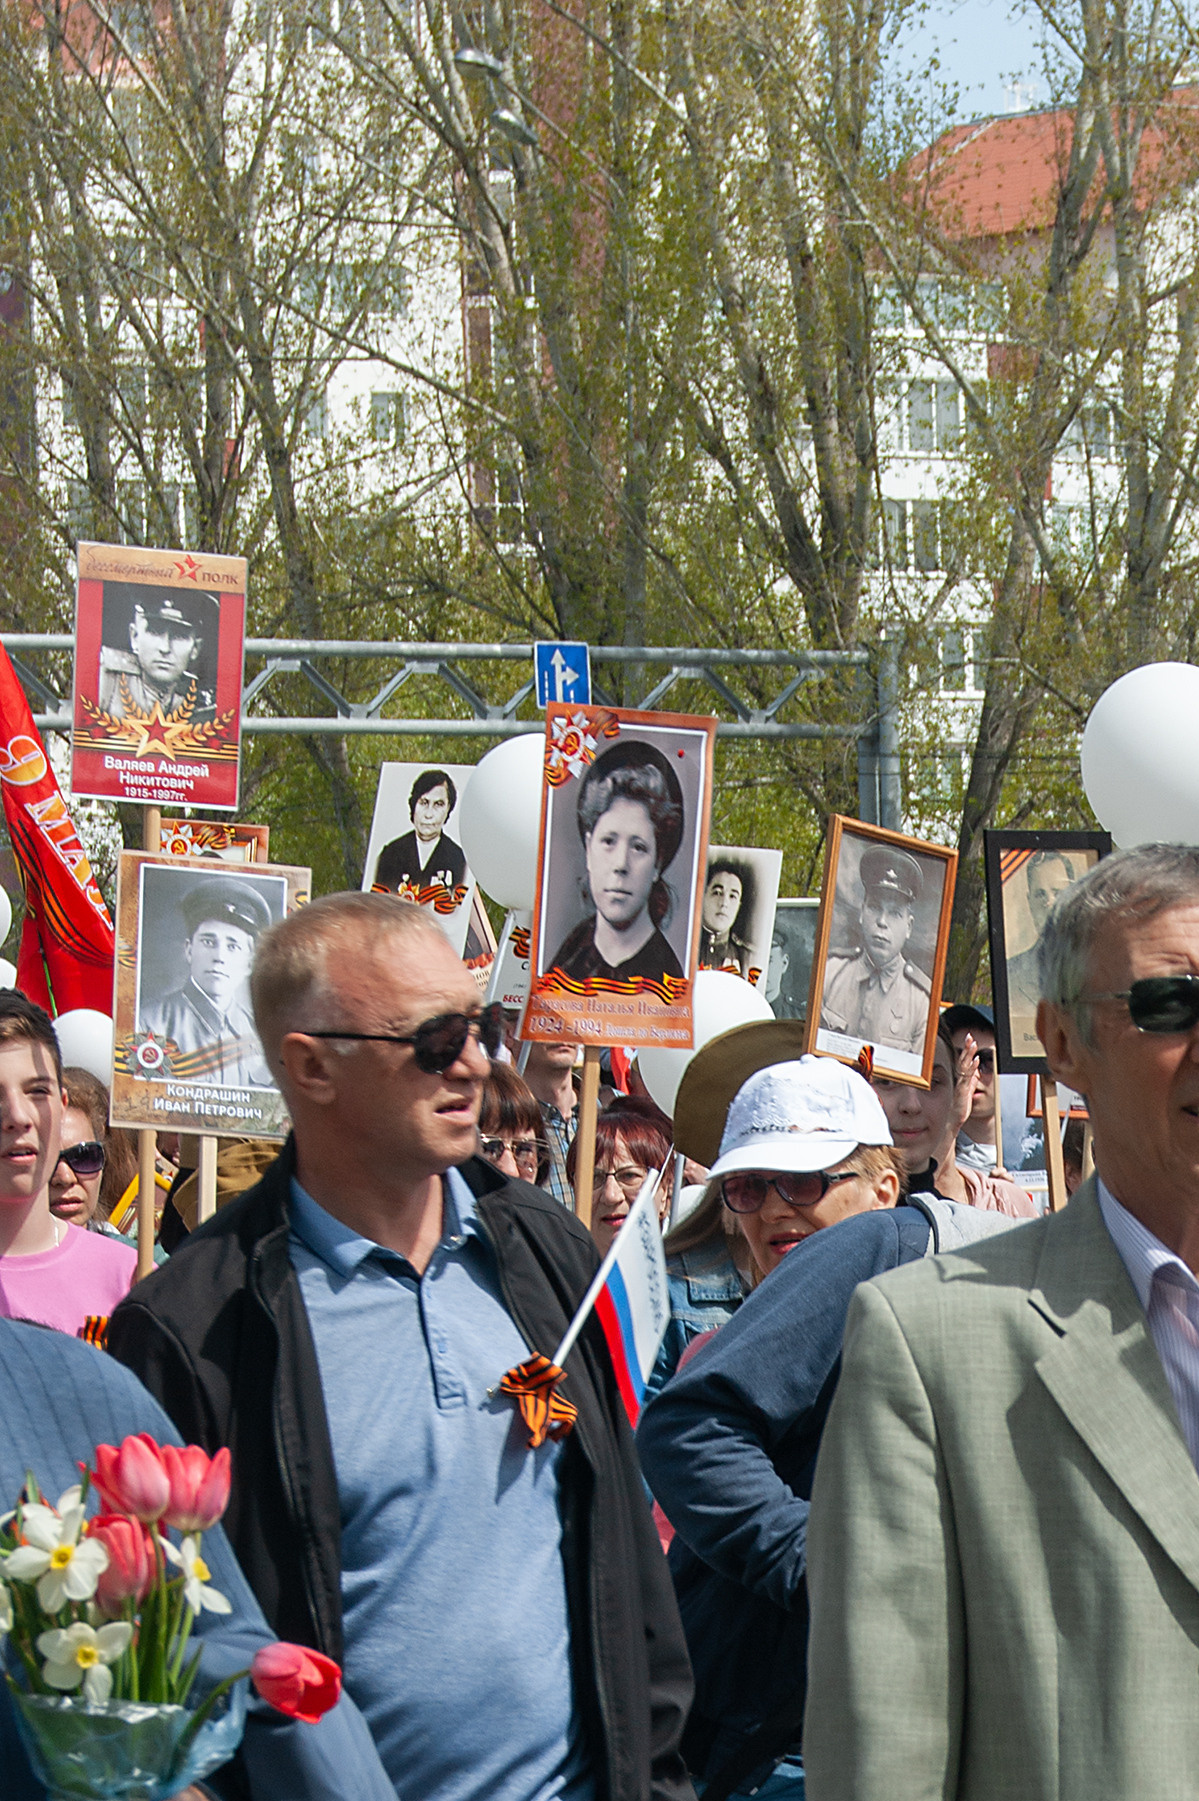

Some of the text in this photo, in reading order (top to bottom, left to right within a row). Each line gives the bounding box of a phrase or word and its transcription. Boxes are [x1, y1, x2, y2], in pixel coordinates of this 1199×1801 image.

[0, 735, 47, 786] 9
[104, 755, 210, 778] Валяев Андрей
[119, 771, 194, 790] Никитович
[503, 994, 524, 1003] БЕСС
[586, 997, 635, 1016] Наталья
[638, 1000, 691, 1018] Ивановна
[1023, 1032, 1038, 1042] Вас
